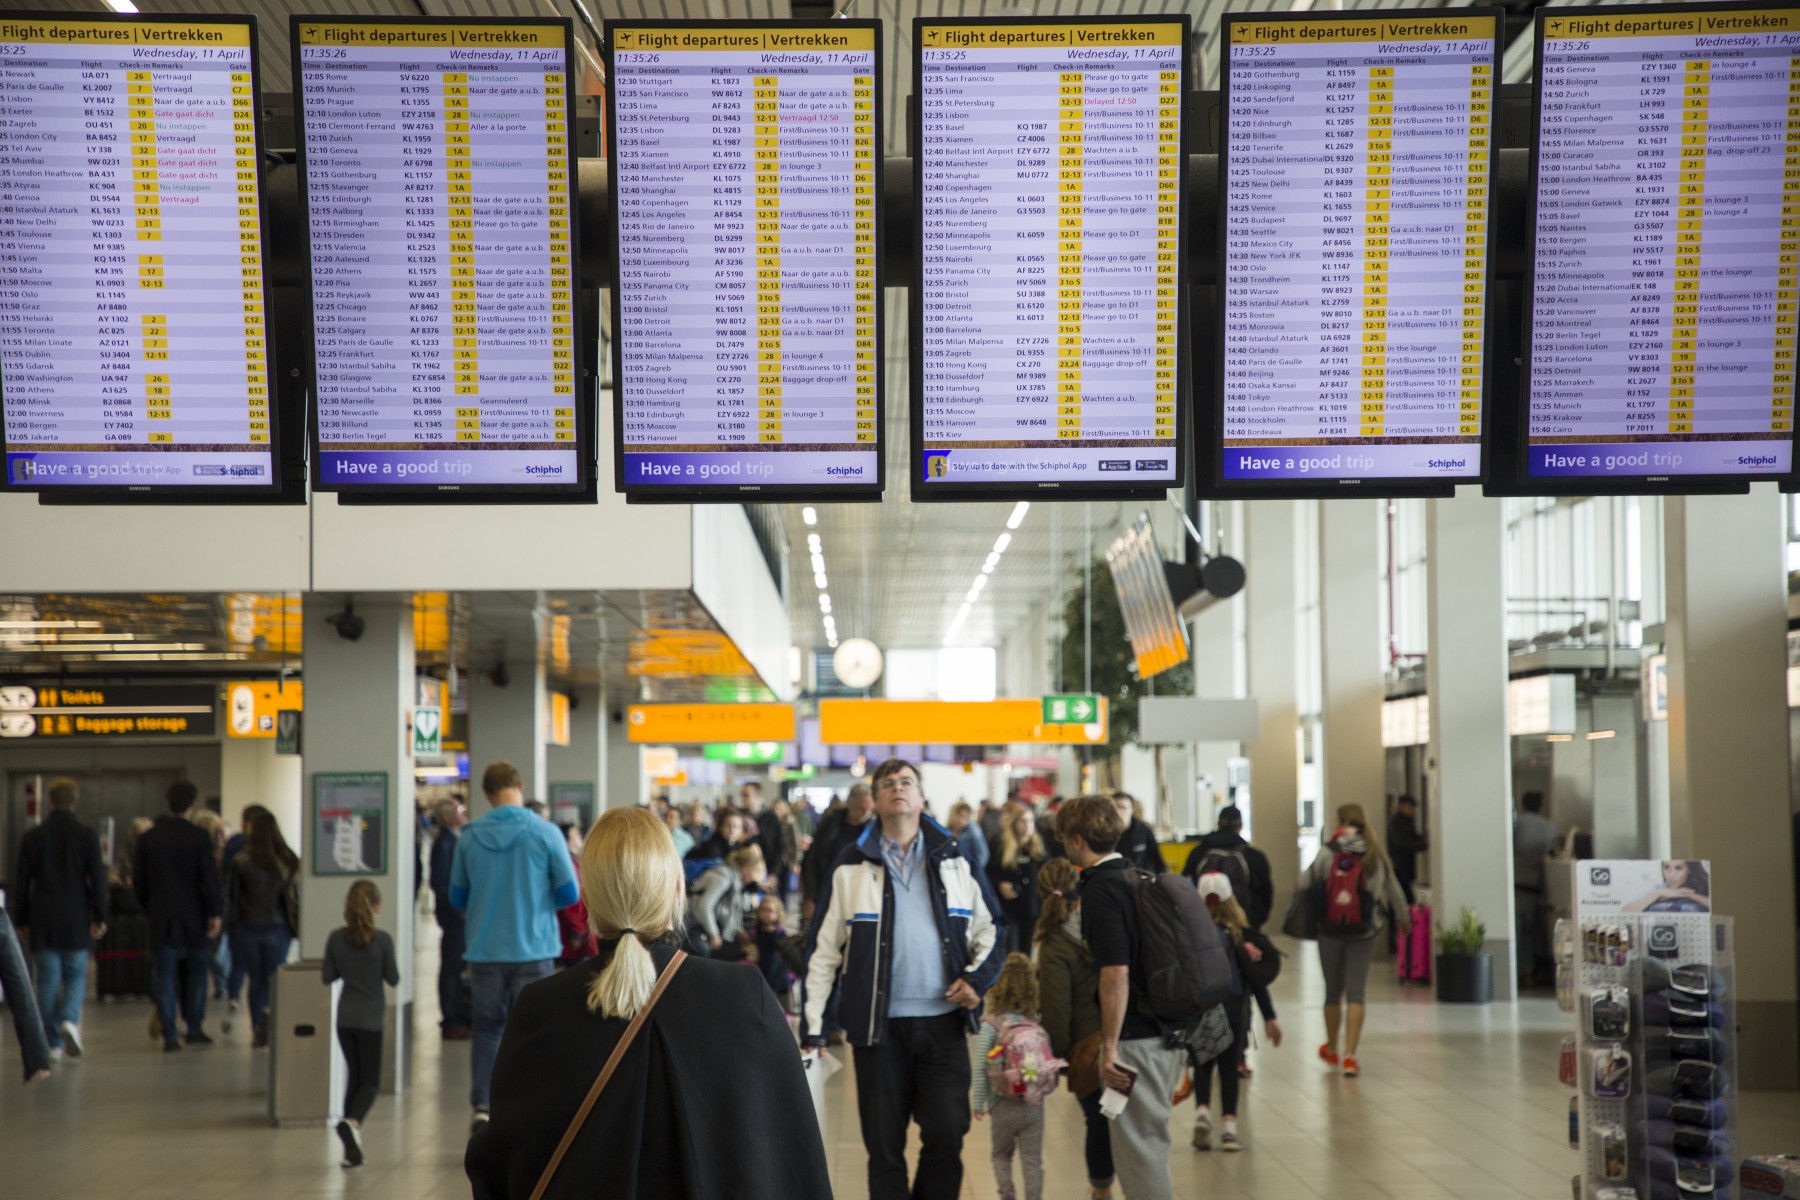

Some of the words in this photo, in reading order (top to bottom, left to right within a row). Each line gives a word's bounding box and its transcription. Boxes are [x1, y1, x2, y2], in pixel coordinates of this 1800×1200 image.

[1569, 20, 1610, 35] Flight
[1614, 18, 1694, 33] departures
[1707, 16, 1788, 29] Vertrekken
[2, 25, 45, 40] Flight
[49, 27, 130, 44] departures
[142, 28, 223, 41] Vertrekken
[325, 29, 366, 43] Flight
[370, 30, 448, 44] departures
[459, 31, 538, 43] Vertrekken
[946, 31, 985, 45] Flight
[990, 30, 1066, 44] departures
[1078, 31, 1155, 42] Vertrekken
[1255, 26, 1295, 41] Flight
[1299, 25, 1377, 39] departures
[1389, 24, 1467, 36] Vertrekken
[638, 34, 679, 48] Flight
[682, 34, 759, 48] departures
[770, 34, 848, 46] Vertrekken
[1546, 41, 1590, 51] 11:35:26
[1695, 35, 1761, 47] Wednesday,
[1765, 36, 1777, 44] 11
[133, 48, 198, 59] Wednesday,
[202, 50, 214, 59] 11
[218, 50, 244, 60] April
[303, 49, 347, 59] 11:35:26
[1067, 49, 1131, 60] Wednesday,
[1134, 49, 1145, 58] 11
[1149, 48, 1175, 59] April
[1233, 46, 1276, 56] 11:35:25
[1378, 43, 1443, 55] Wednesday,
[1446, 43, 1458, 52] 11
[1461, 42, 1487, 52] April
[450, 50, 514, 61] Wednesday,
[517, 50, 529, 60] 11
[532, 50, 558, 61] April
[618, 54, 660, 63] 11:35:26
[761, 54, 824, 64] Wednesday,
[827, 54, 839, 63] 11
[842, 54, 868, 64] April
[924, 51, 966, 60] 11:35:25
[1085, 73, 1108, 81] Please
[1130, 74, 1149, 82] gate
[619, 114, 639, 122] 12:35
[640, 114, 690, 123] St.Petersburg
[780, 114, 817, 122] Vertraagd
[470, 123, 489, 131] Aller
[491, 123, 496, 131] à
[498, 123, 505, 131] la
[507, 124, 527, 132] porte
[1231, 168, 1250, 176] 14:25
[1557, 319, 1591, 327] Montreal
[1699, 316, 1749, 324] First/Business
[1778, 315, 1787, 323] E2
[99, 327, 110, 335] AC
[111, 327, 125, 335] 825
[1555, 355, 1592, 363] Barcelona
[1776, 351, 1790, 359] B15
[9, 433, 29, 441] 12:05
[31, 433, 59, 441] Jakarta
[1240, 456, 1280, 470] Have
[1285, 459, 1294, 469] a
[1299, 456, 1341, 472] good
[1345, 455, 1375, 471] trip
[1428, 459, 1466, 470] Schiphol
[1545, 454, 1586, 467] Have
[1591, 456, 1600, 466] a
[1606, 454, 1648, 470] good
[1652, 453, 1683, 469] trip
[1738, 455, 1776, 466] Schiphol
[337, 460, 378, 474] Have
[383, 463, 392, 474] a
[397, 461, 441, 478] good
[444, 460, 472, 479] trip
[525, 465, 562, 475] Schiphol
[641, 462, 681, 475] Have
[686, 465, 695, 475] a
[700, 462, 742, 479] good
[746, 461, 774, 479] trip
[827, 466, 863, 476] Schiphol
[953, 462, 969, 471] Stay
[991, 462, 1007, 470] date
[1009, 462, 1025, 470] with
[1026, 462, 1039, 470] the
[1040, 462, 1071, 471] Schiphol
[1072, 462, 1087, 470] App
[61, 690, 104, 705] Toilets
[76, 717, 134, 733] Baggage
[136, 717, 187, 733] storage
